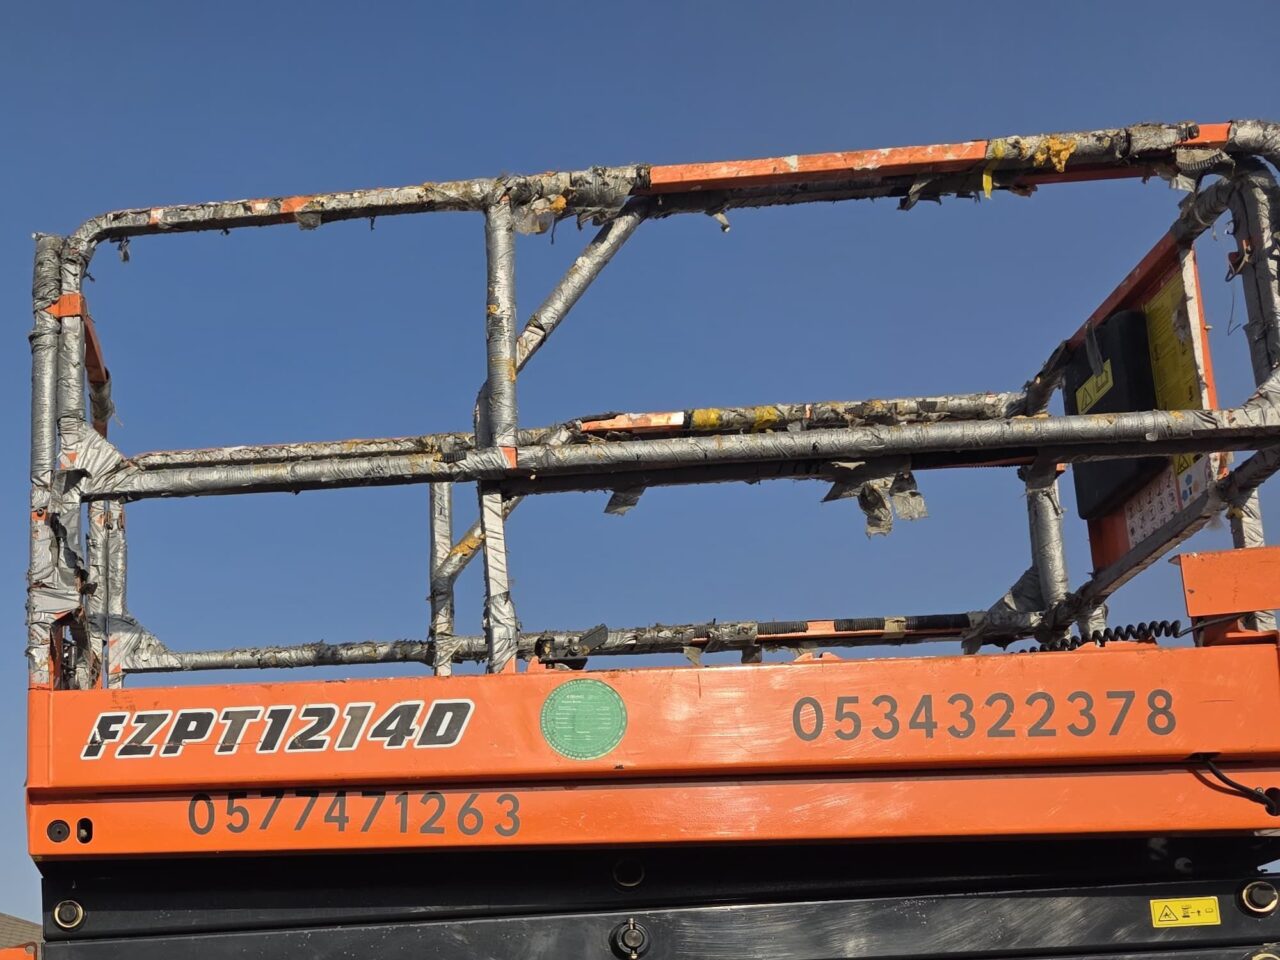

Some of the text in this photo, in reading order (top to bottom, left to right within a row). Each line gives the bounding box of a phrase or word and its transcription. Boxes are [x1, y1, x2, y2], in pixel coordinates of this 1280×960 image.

[81, 698, 476, 761] FZPT1214D
[792, 688, 1178, 741] 0534322378
[189, 789, 522, 838] 0577471263
